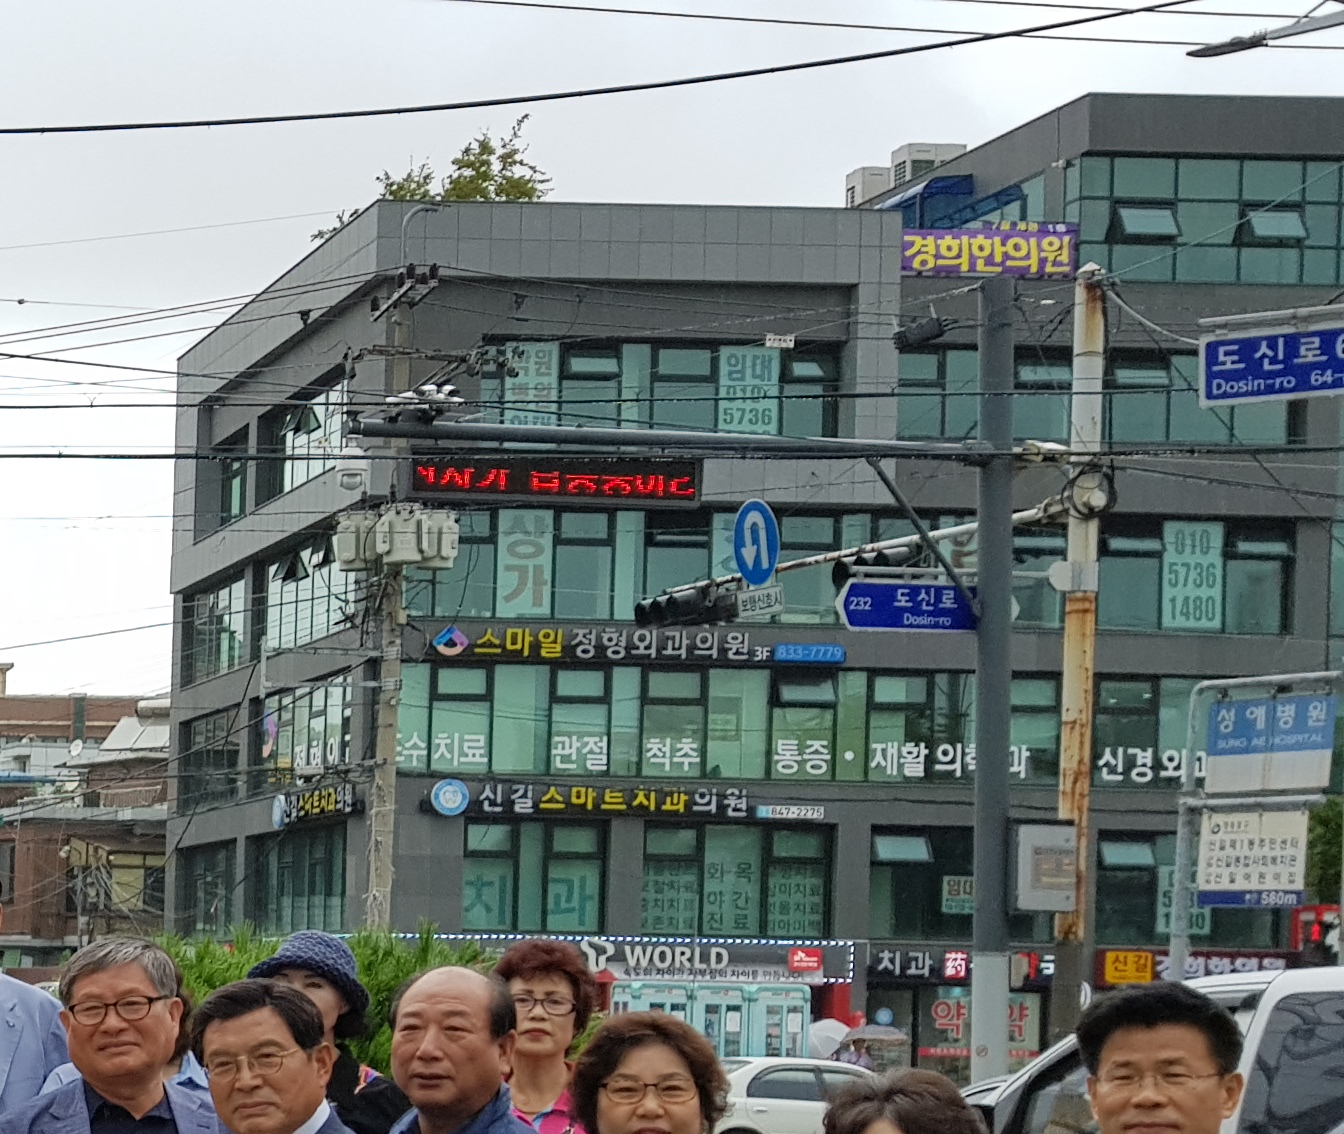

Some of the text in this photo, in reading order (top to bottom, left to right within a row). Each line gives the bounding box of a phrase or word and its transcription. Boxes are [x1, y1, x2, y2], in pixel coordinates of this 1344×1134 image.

[903, 234, 1072, 274] 경희한의원
[726, 352, 774, 382] 임대
[1212, 375, 1296, 395] Dosin-ro
[723, 407, 773, 426] 5736
[1175, 528, 1211, 555] 010
[1167, 561, 1217, 589] 5736
[849, 596, 872, 610] 232
[893, 588, 958, 611] 도신로
[1168, 595, 1216, 622] 1480
[903, 612, 952, 627] Dosin-ro
[473, 627, 842, 661] 스마일 정형외과의원 3F 833-7779
[1217, 700, 1327, 733] 성애병원
[552, 735, 609, 771] 관절
[646, 738, 701, 772] 척추
[773, 739, 832, 775] 통증
[771, 806, 823, 818] 847-2275
[624, 945, 730, 970] WORLD
[877, 950, 933, 978] 치과
[1112, 954, 1149, 972] 신길
[931, 1000, 967, 1038] 약
